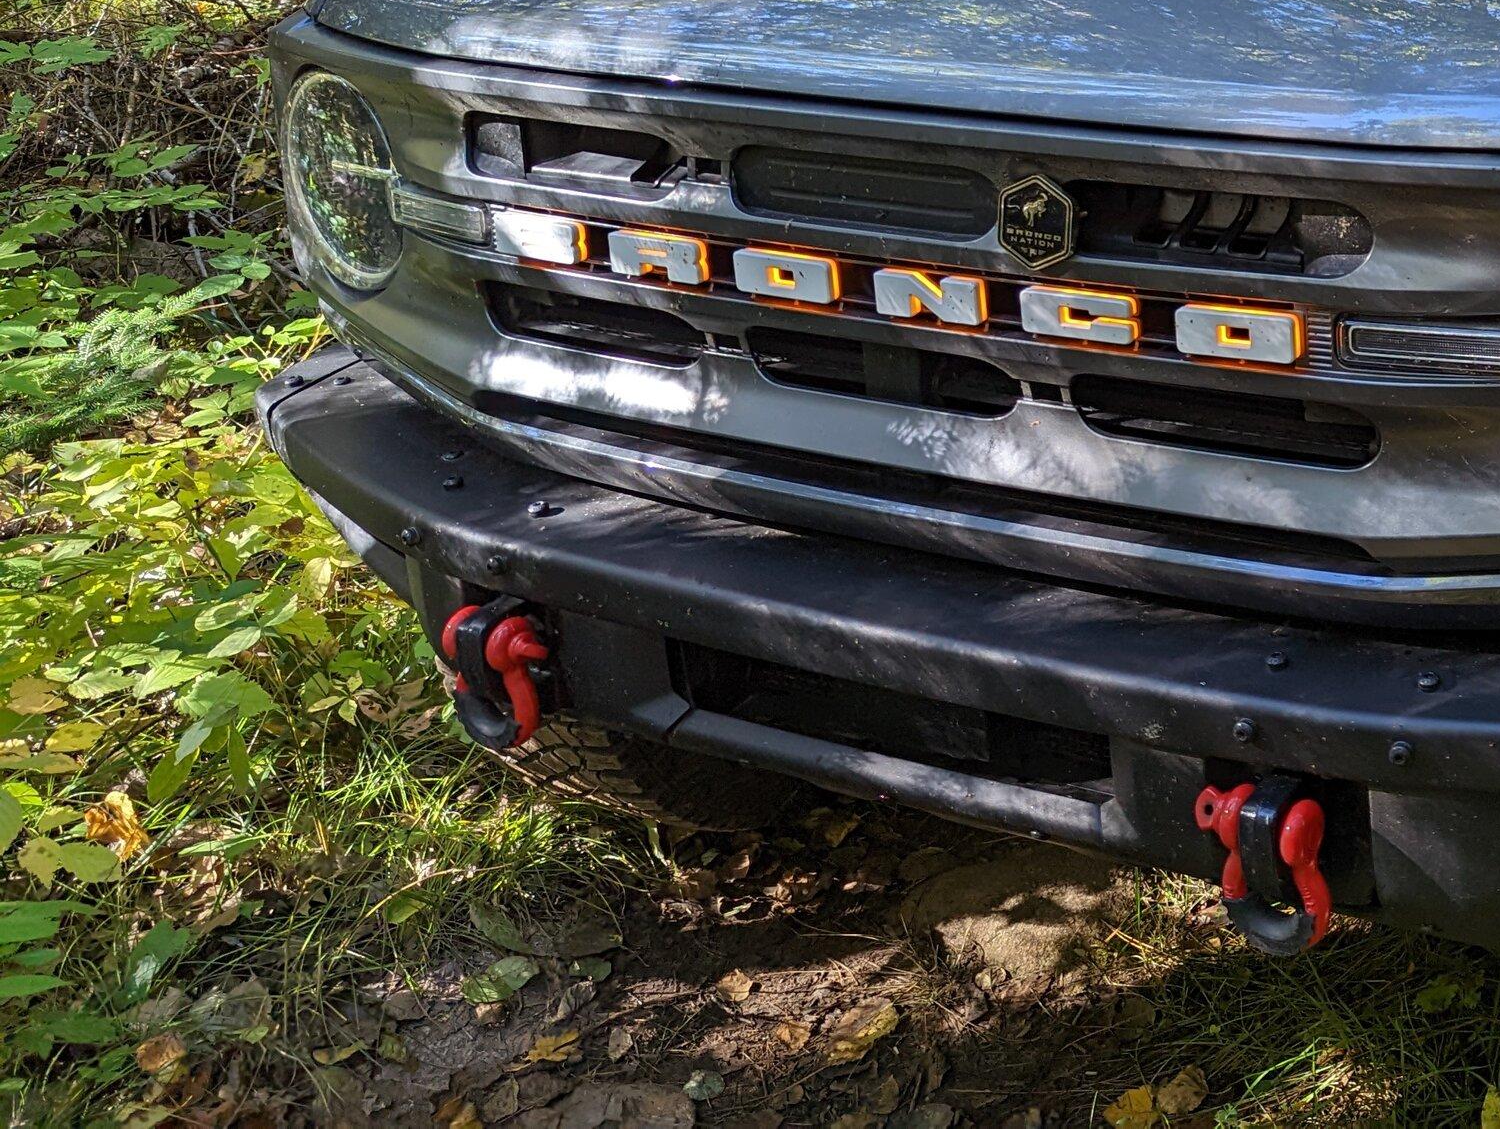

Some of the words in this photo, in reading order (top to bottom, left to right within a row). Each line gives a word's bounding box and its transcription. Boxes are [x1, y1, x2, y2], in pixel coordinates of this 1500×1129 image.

[1006, 228, 1062, 242] BRONCO
[1010, 235, 1055, 248] NATION
[494, 210, 1304, 365] BRONCO
